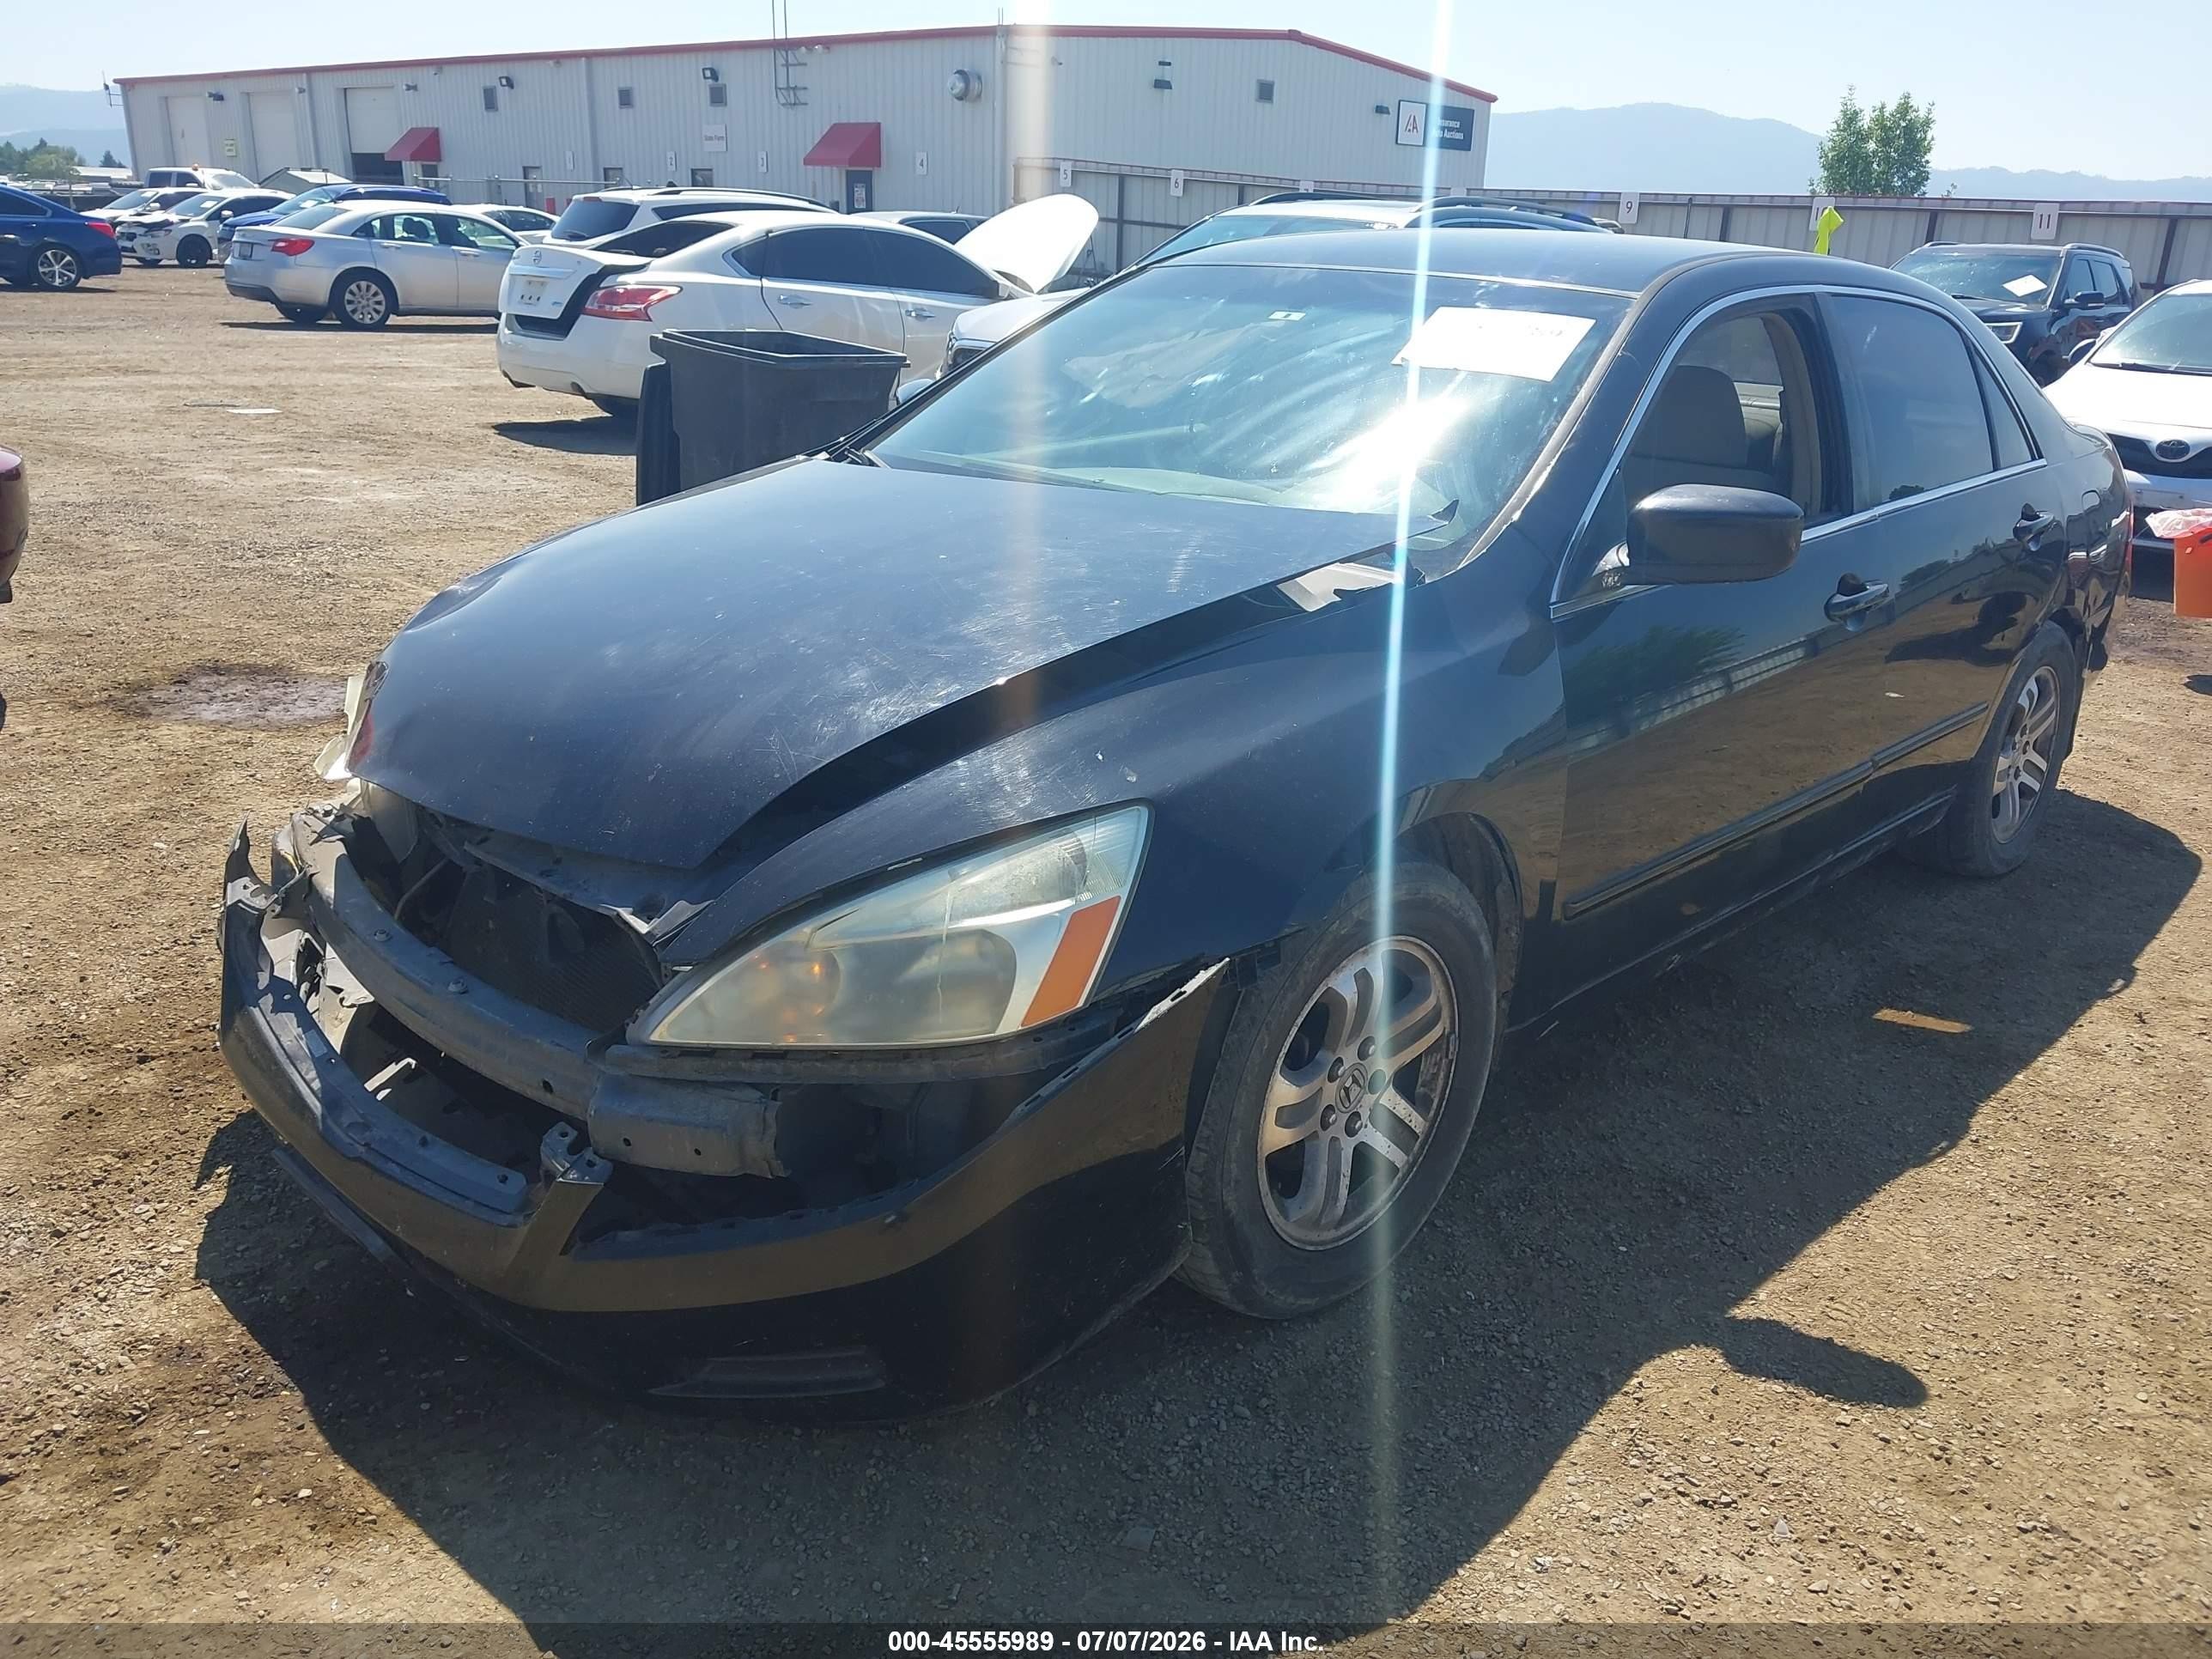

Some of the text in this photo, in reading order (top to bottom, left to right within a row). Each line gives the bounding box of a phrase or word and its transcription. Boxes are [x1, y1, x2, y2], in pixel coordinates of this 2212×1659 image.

[1443, 129, 1464, 140] Auctions
[669, 156, 674, 166] 2
[919, 158, 924, 168] 4
[1063, 169, 1068, 179] 5
[1174, 178, 1180, 188] 6
[1626, 200, 1633, 214] 9
[2039, 213, 2051, 229] 11
